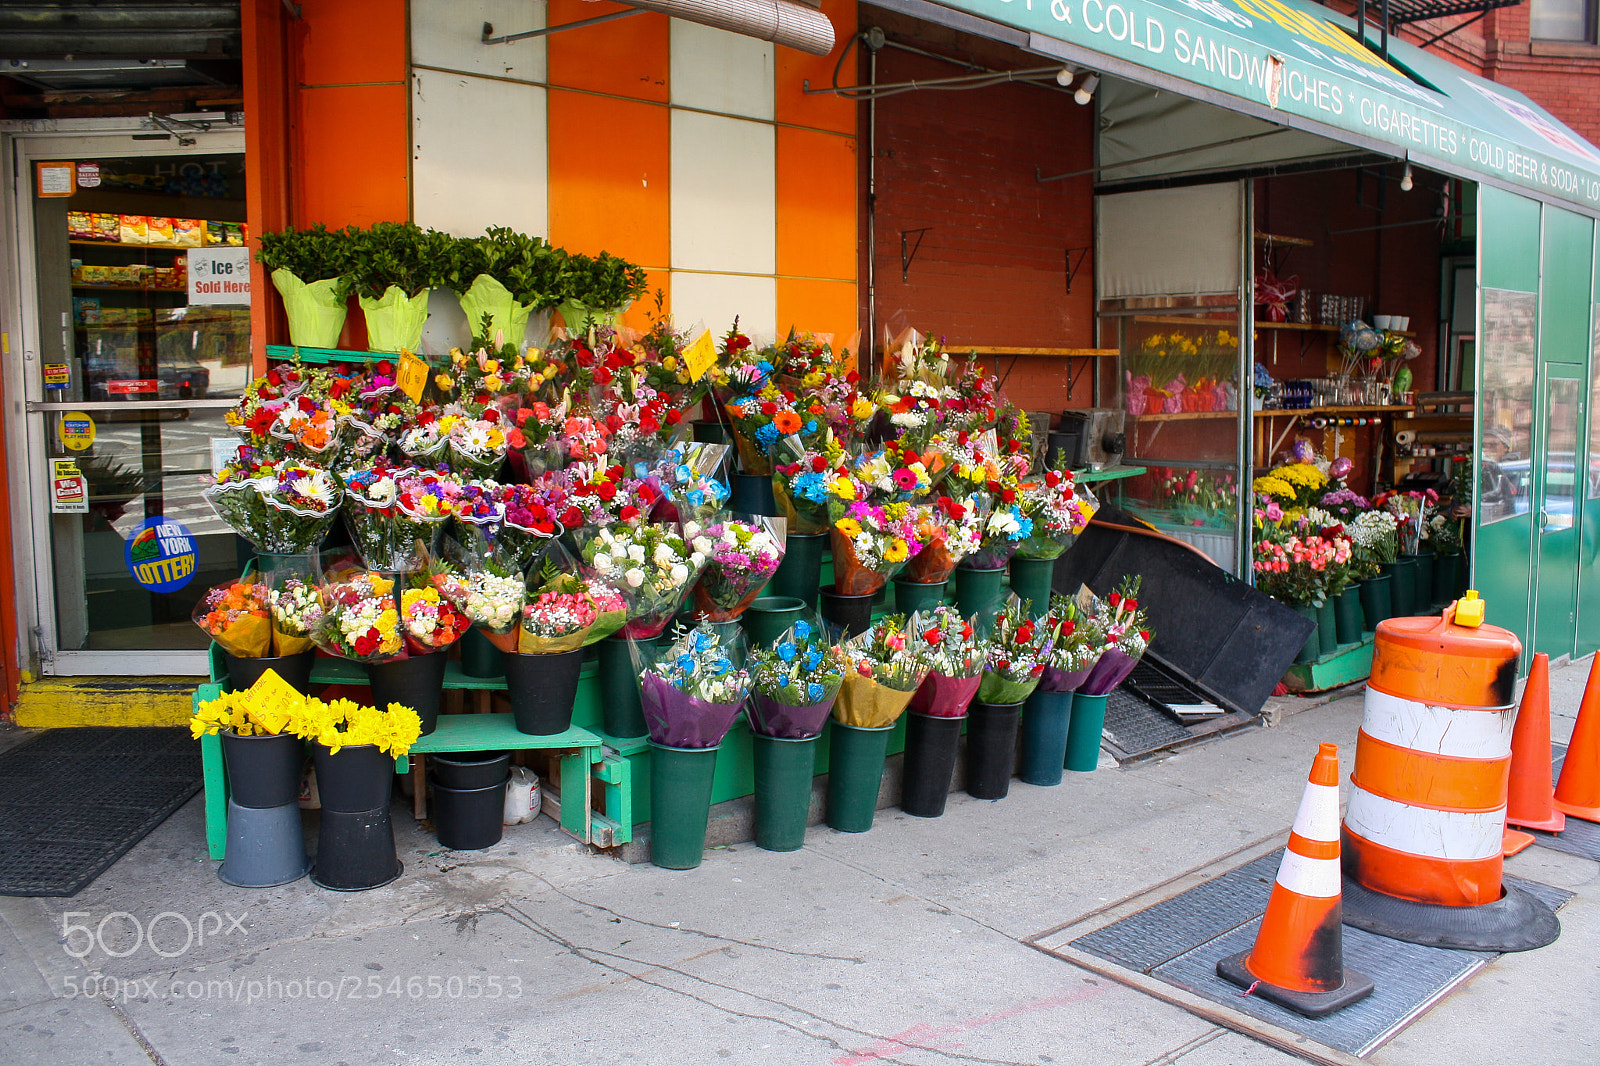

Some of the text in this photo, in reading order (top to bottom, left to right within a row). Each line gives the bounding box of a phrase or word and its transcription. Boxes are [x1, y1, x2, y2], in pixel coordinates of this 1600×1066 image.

[1082, 0, 1166, 54] COLD
[1174, 28, 1344, 116] SANDWICHES
[1360, 97, 1457, 155] CIGARETTES
[1469, 137, 1504, 171] COLD
[1507, 150, 1538, 182] BEER
[1541, 162, 1548, 185] &
[1550, 166, 1579, 196] SODA
[1586, 178, 1600, 201] LO
[211, 260, 233, 275] Ice
[195, 281, 250, 293] Sold Here
[56, 485, 82, 497] Card
[59, 479, 77, 489] We
[155, 524, 183, 538] NEW
[160, 537, 192, 556] YORK
[133, 553, 195, 584] LOTTERY
